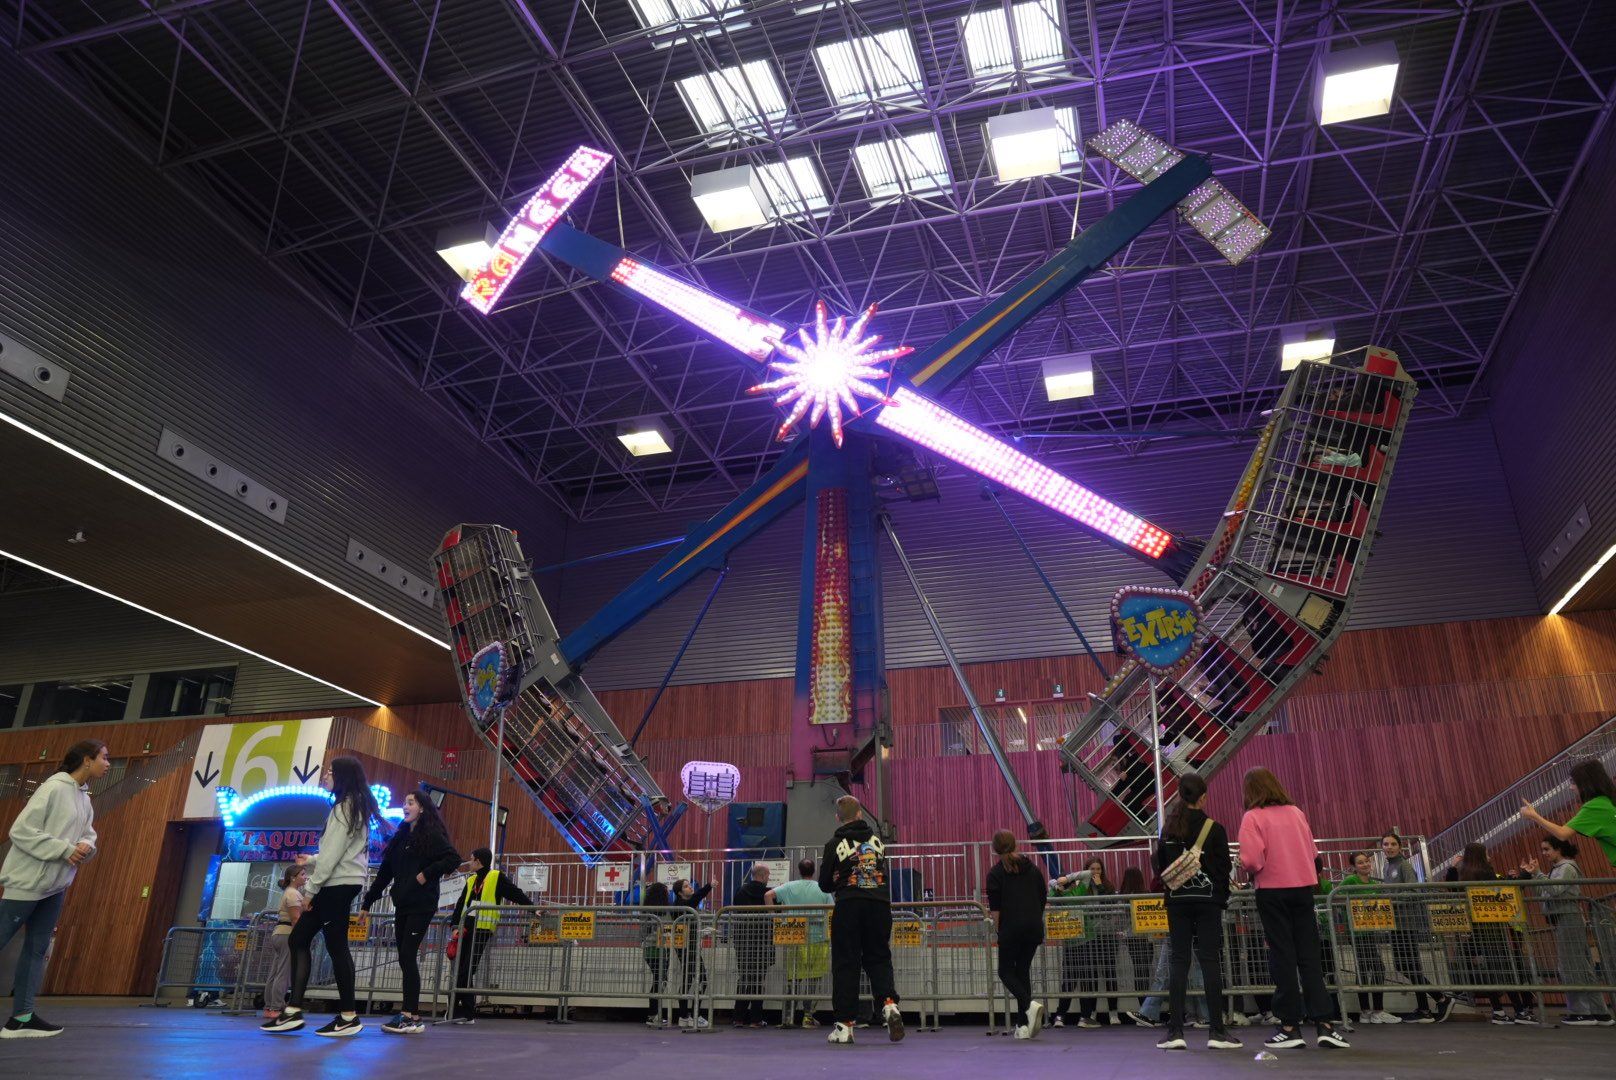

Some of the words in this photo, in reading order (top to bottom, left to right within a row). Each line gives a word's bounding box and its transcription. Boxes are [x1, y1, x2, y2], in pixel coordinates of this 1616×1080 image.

[472, 153, 602, 300] RANGER
[1120, 608, 1197, 648] EXTREME
[230, 724, 283, 800] 6
